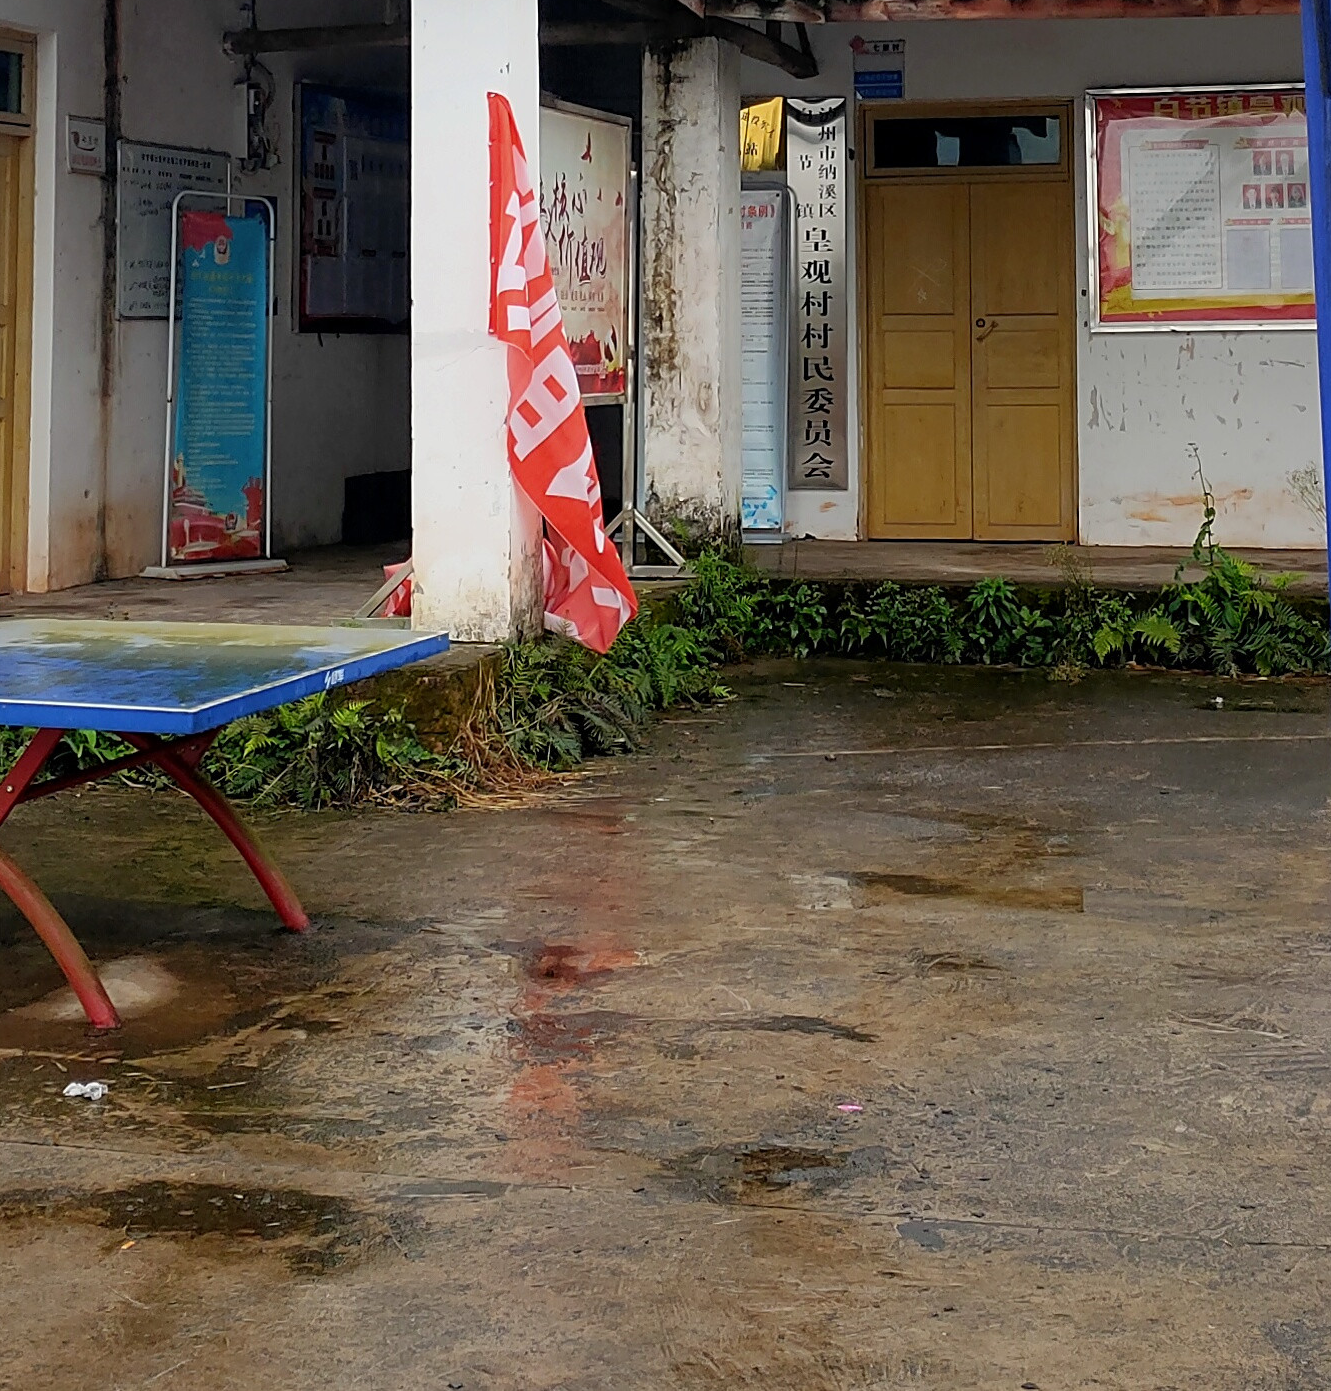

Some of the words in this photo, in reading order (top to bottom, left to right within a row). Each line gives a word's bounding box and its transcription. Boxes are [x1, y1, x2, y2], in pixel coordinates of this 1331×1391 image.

[799, 226, 835, 480] 皇观村村民委员会
